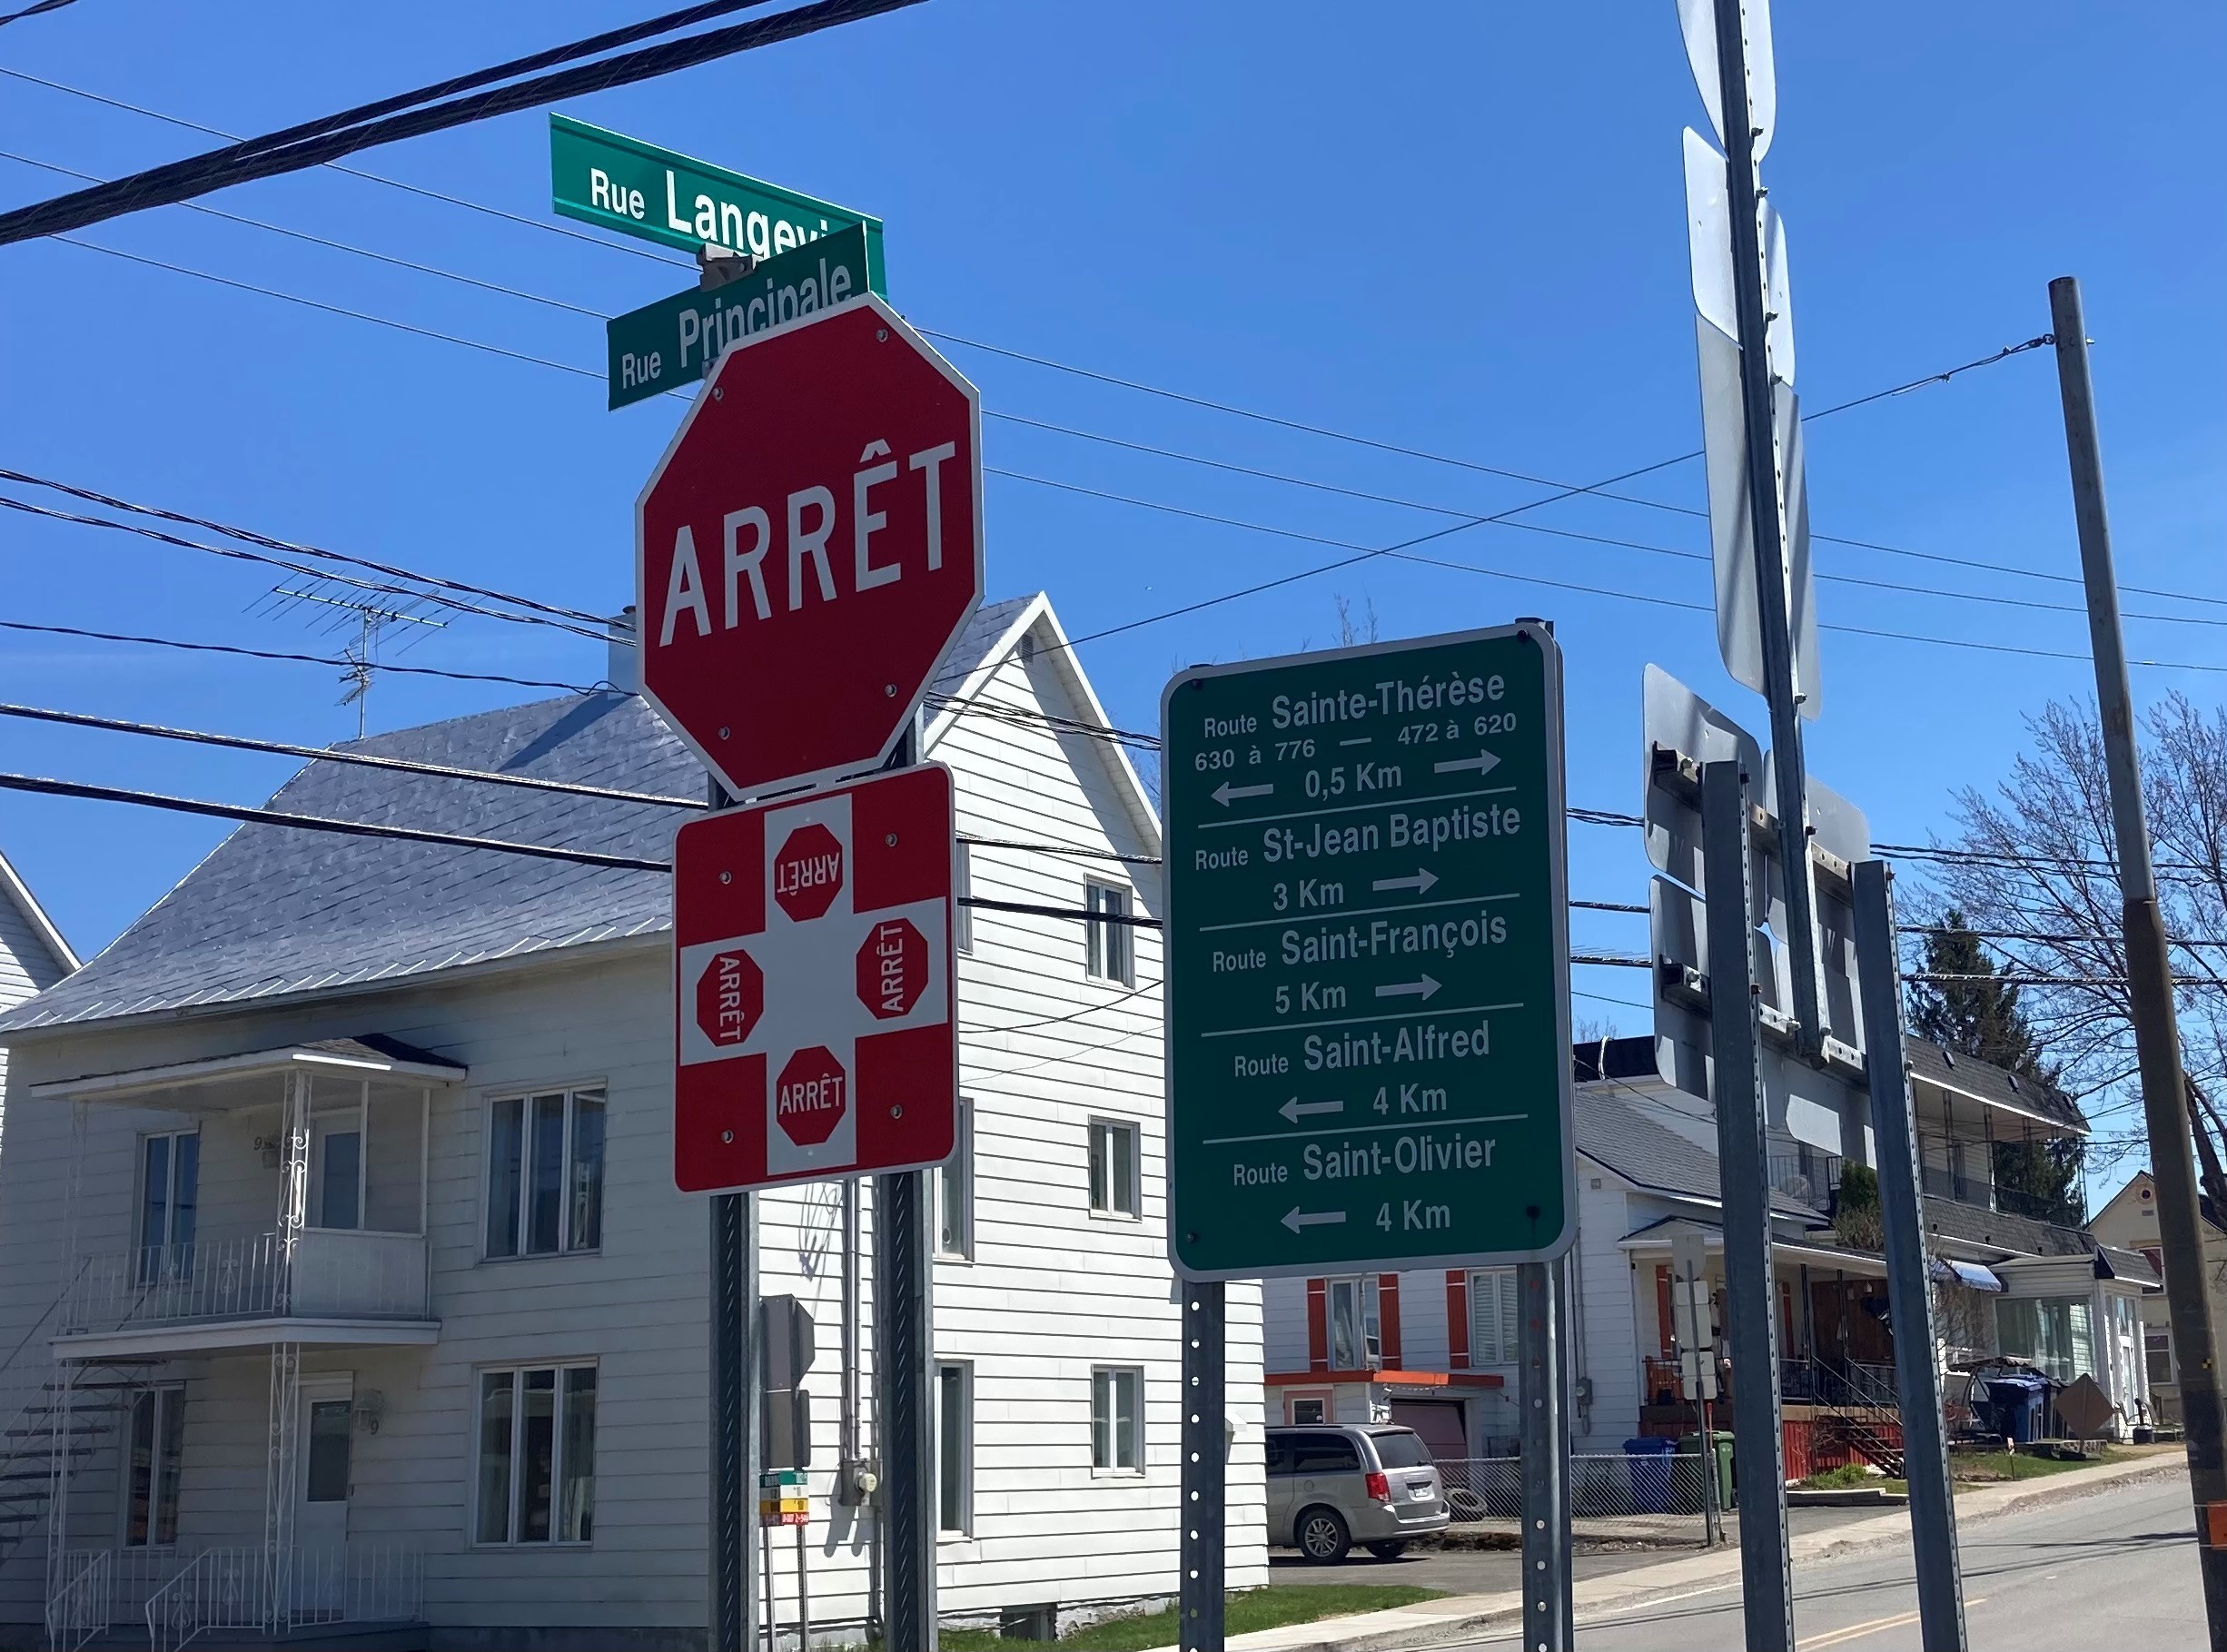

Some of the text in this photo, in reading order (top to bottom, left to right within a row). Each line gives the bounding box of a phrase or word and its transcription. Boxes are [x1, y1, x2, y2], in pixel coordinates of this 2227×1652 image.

[591, 168, 645, 220] Rue
[622, 258, 852, 390] Rue Principale
[659, 439, 955, 647] ARRÊT
[1204, 671, 1505, 738] Route Sainte-Thérèse
[1194, 748, 1235, 772] 630
[1249, 745, 1262, 765] à
[1274, 738, 1316, 762] 776
[1397, 723, 1439, 745] 472
[1446, 719, 1460, 740] à
[1474, 712, 1518, 737] 620
[1305, 761, 1402, 801] 0,5 Km
[1195, 803, 1521, 871] Route St-Jean Baptiste
[778, 853, 840, 896] ARRÊT
[1273, 878, 1344, 911] 3 Km
[876, 925, 904, 1013] ARRÊT
[1212, 911, 1507, 973] Route Saint-François
[719, 956, 745, 1040] ARRÊT
[1275, 981, 1346, 1014] 5 Km
[1234, 1020, 1490, 1078] Route Saint-Alfred
[779, 1073, 843, 1114] ARRÊT
[1372, 1083, 1448, 1115] 4 Km
[1233, 1133, 1497, 1186] Route Saint-Olivier
[1376, 1199, 1451, 1232] 4 Km
